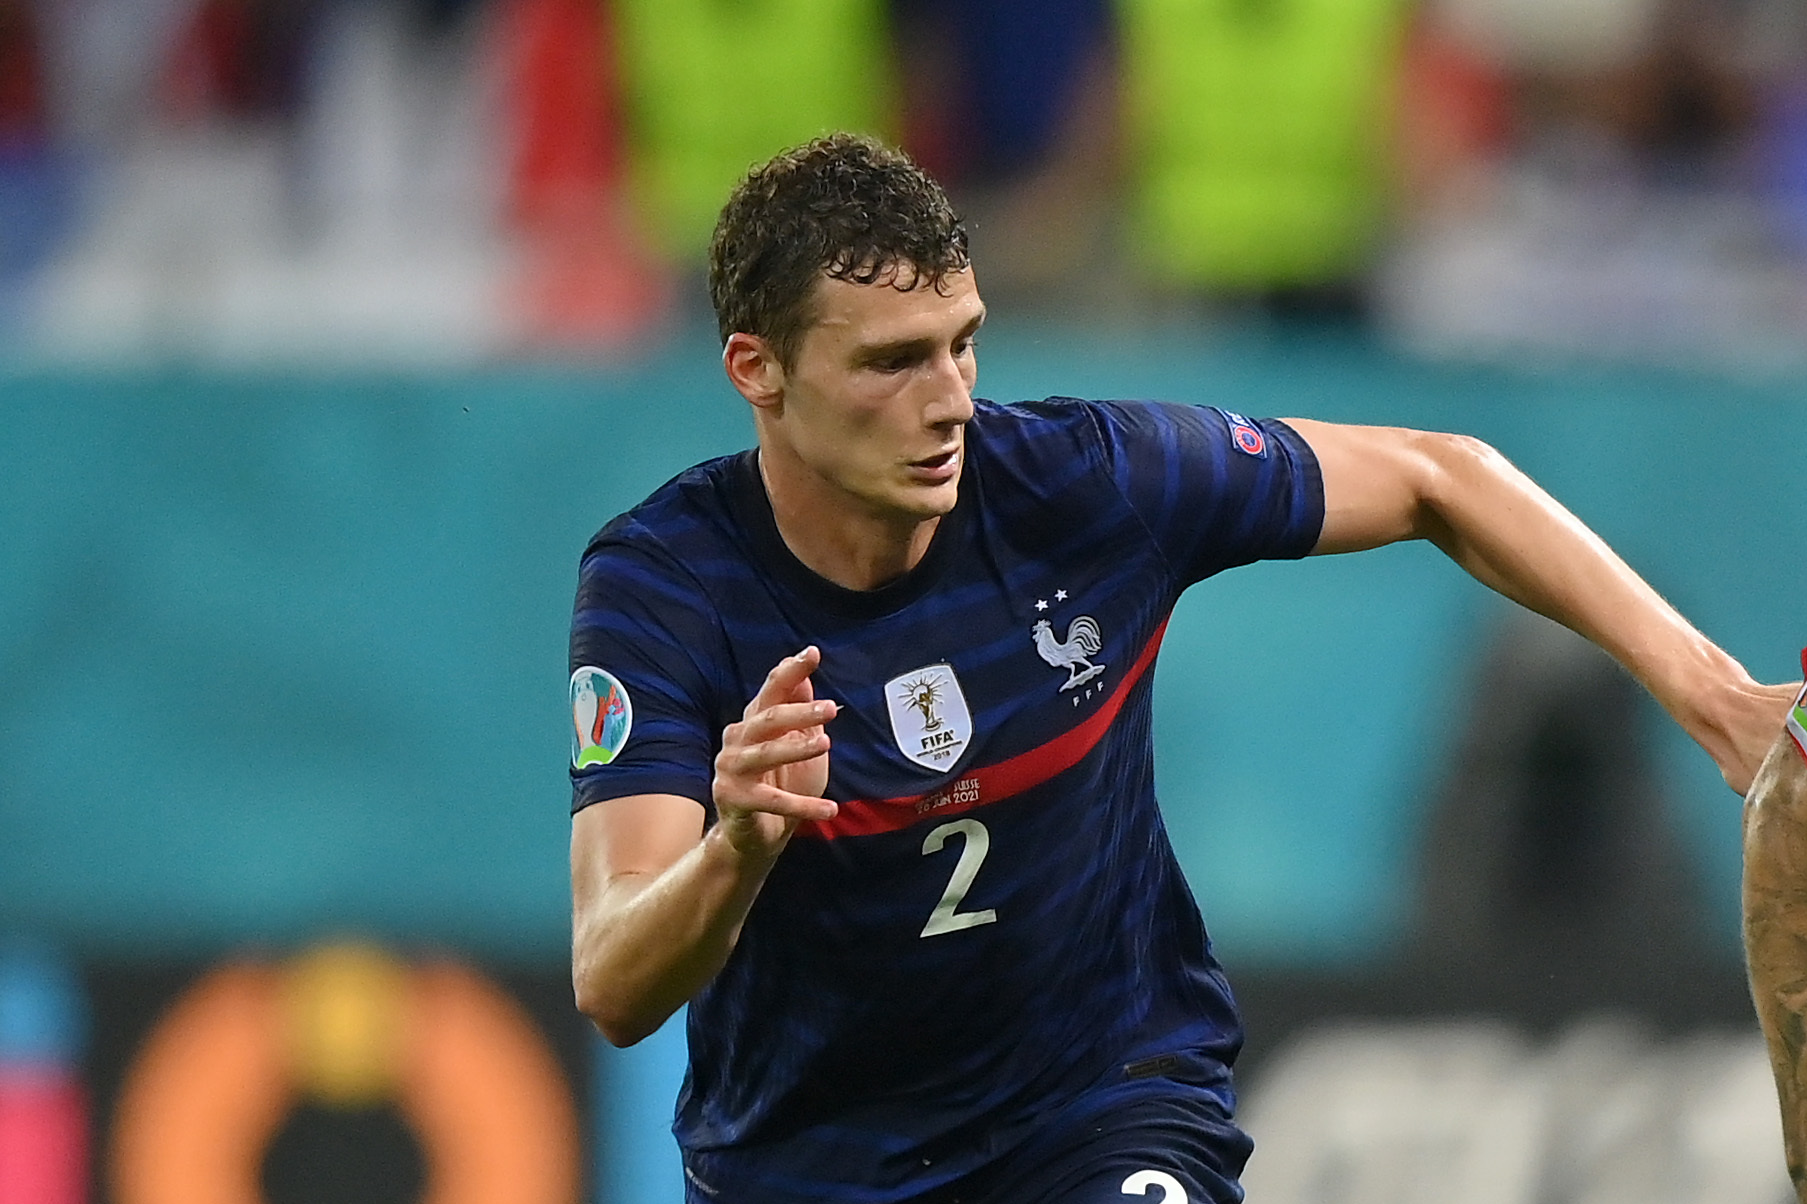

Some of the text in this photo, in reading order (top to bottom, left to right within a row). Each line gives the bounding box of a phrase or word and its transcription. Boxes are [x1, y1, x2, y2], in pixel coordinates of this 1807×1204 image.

[921, 730, 954, 749] FIFA
[953, 789, 980, 804] 2021
[920, 818, 997, 938] 2
